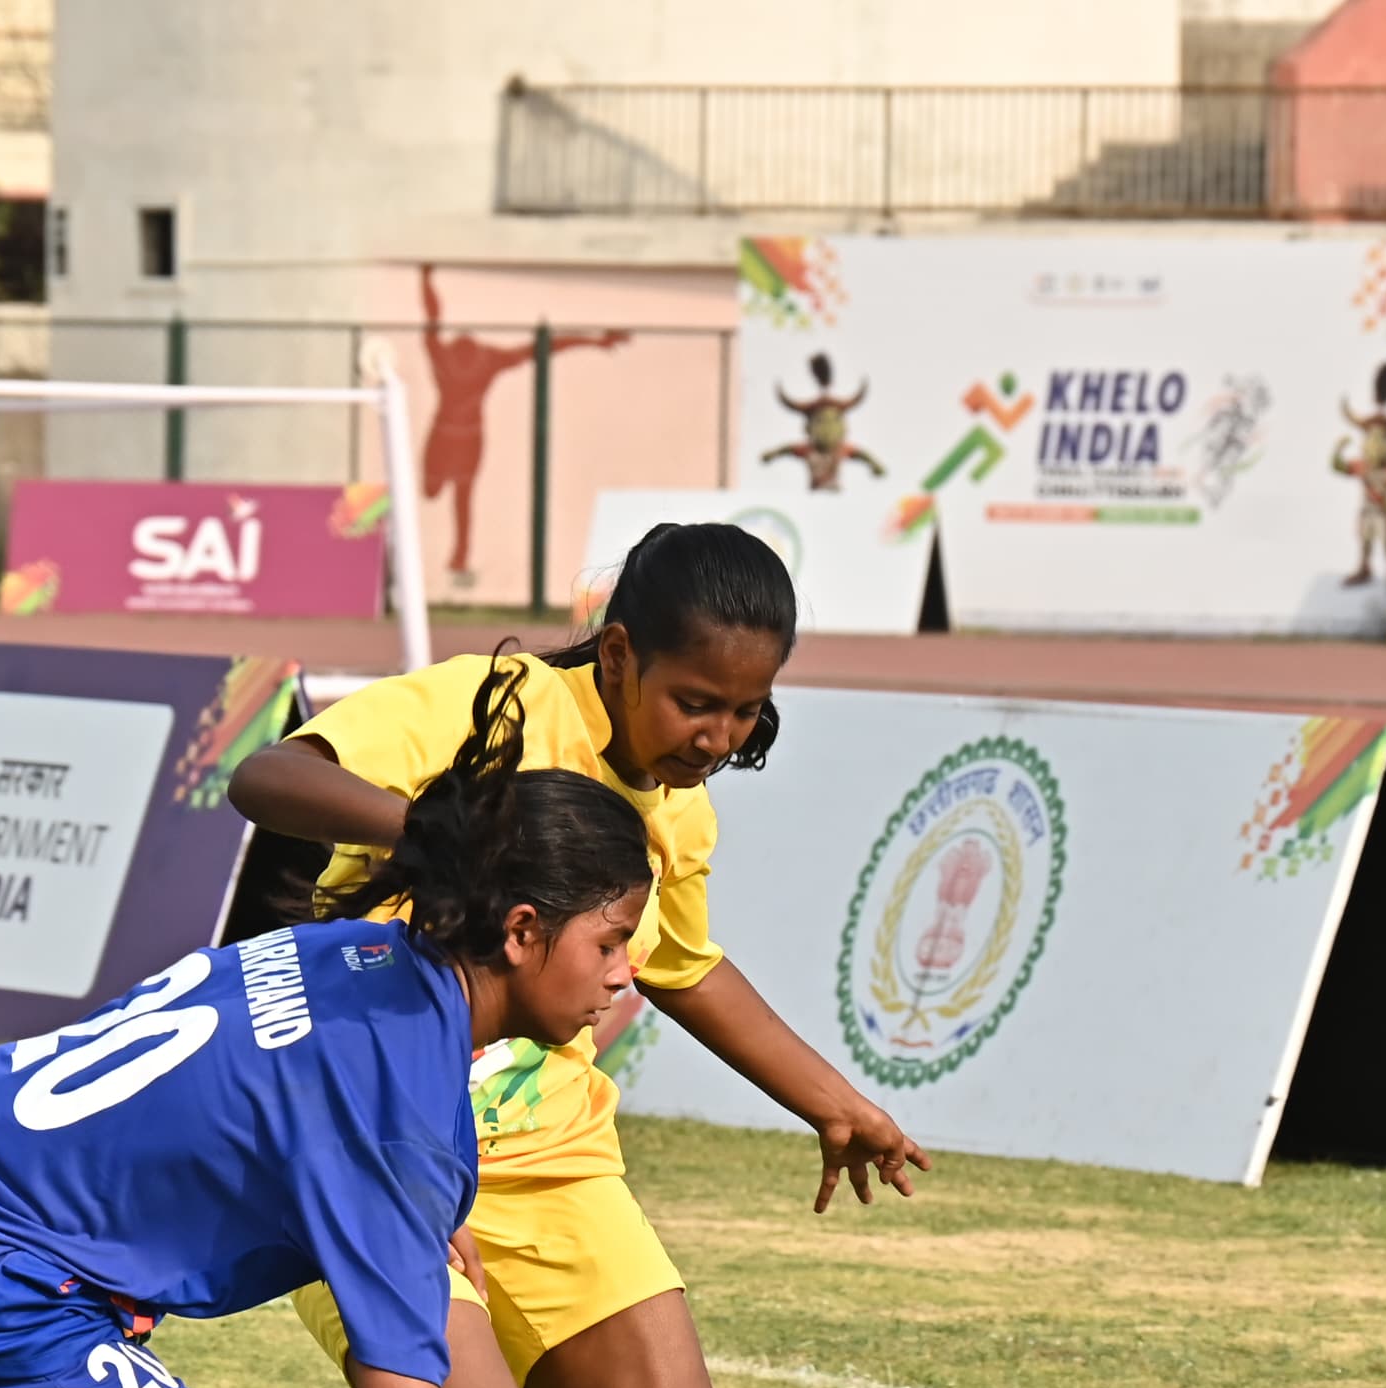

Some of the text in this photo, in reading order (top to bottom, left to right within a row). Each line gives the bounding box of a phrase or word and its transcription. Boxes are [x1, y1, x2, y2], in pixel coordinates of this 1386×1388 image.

[1044, 370, 1186, 415] KHELO
[1037, 421, 1160, 465] INDIA
[127, 493, 263, 584] SAI
[340, 945, 365, 972] INDIA
[11, 952, 220, 1132] 20
